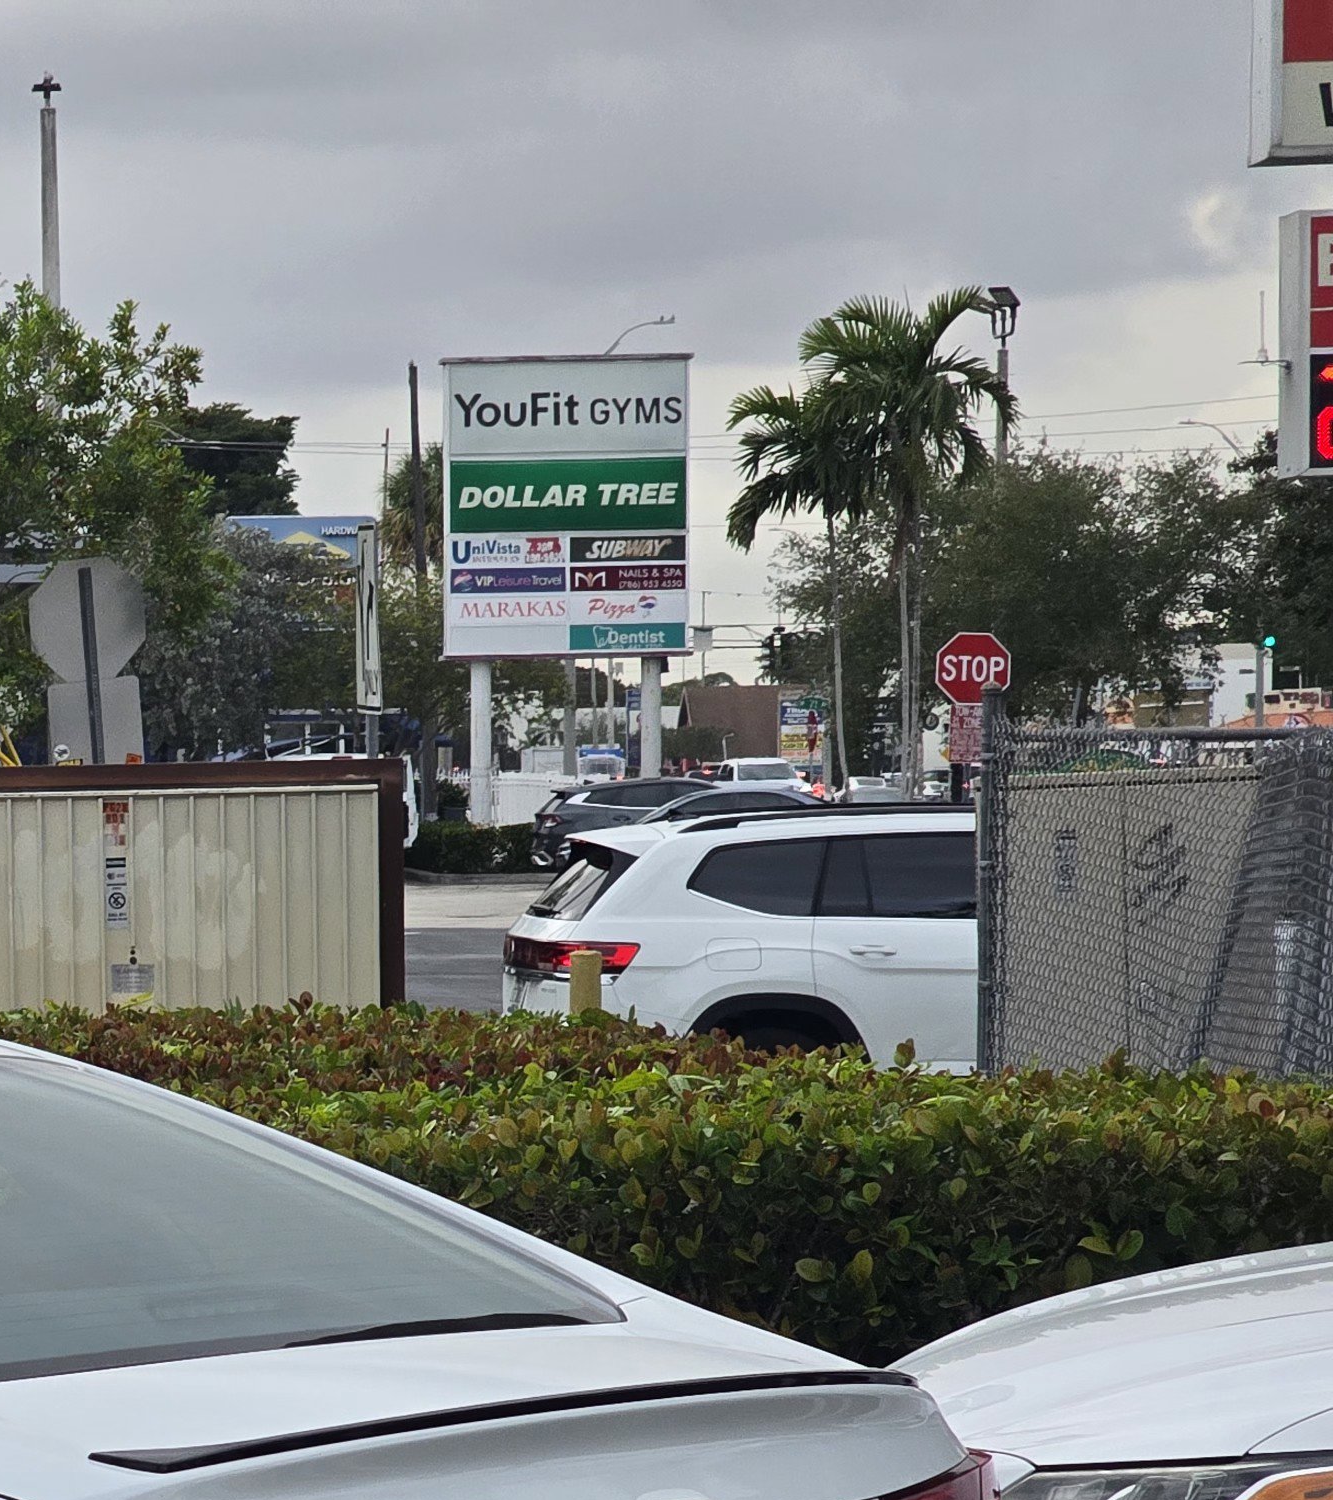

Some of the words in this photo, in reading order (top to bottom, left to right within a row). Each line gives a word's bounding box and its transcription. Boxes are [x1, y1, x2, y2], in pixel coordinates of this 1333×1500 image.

[454, 392, 579, 428] YouFit
[590, 396, 682, 425] GYMS
[458, 484, 587, 509] DOLLAR
[598, 482, 678, 506] TREE
[452, 540, 521, 564] UniVista
[586, 538, 672, 558] SUBWAY
[619, 568, 648, 578] NAILS
[663, 568, 682, 577] SPA
[459, 600, 566, 619] MARAKAS
[588, 598, 636, 619] Pizza
[608, 630, 665, 643] Dentist
[941, 655, 1005, 683] STOP
